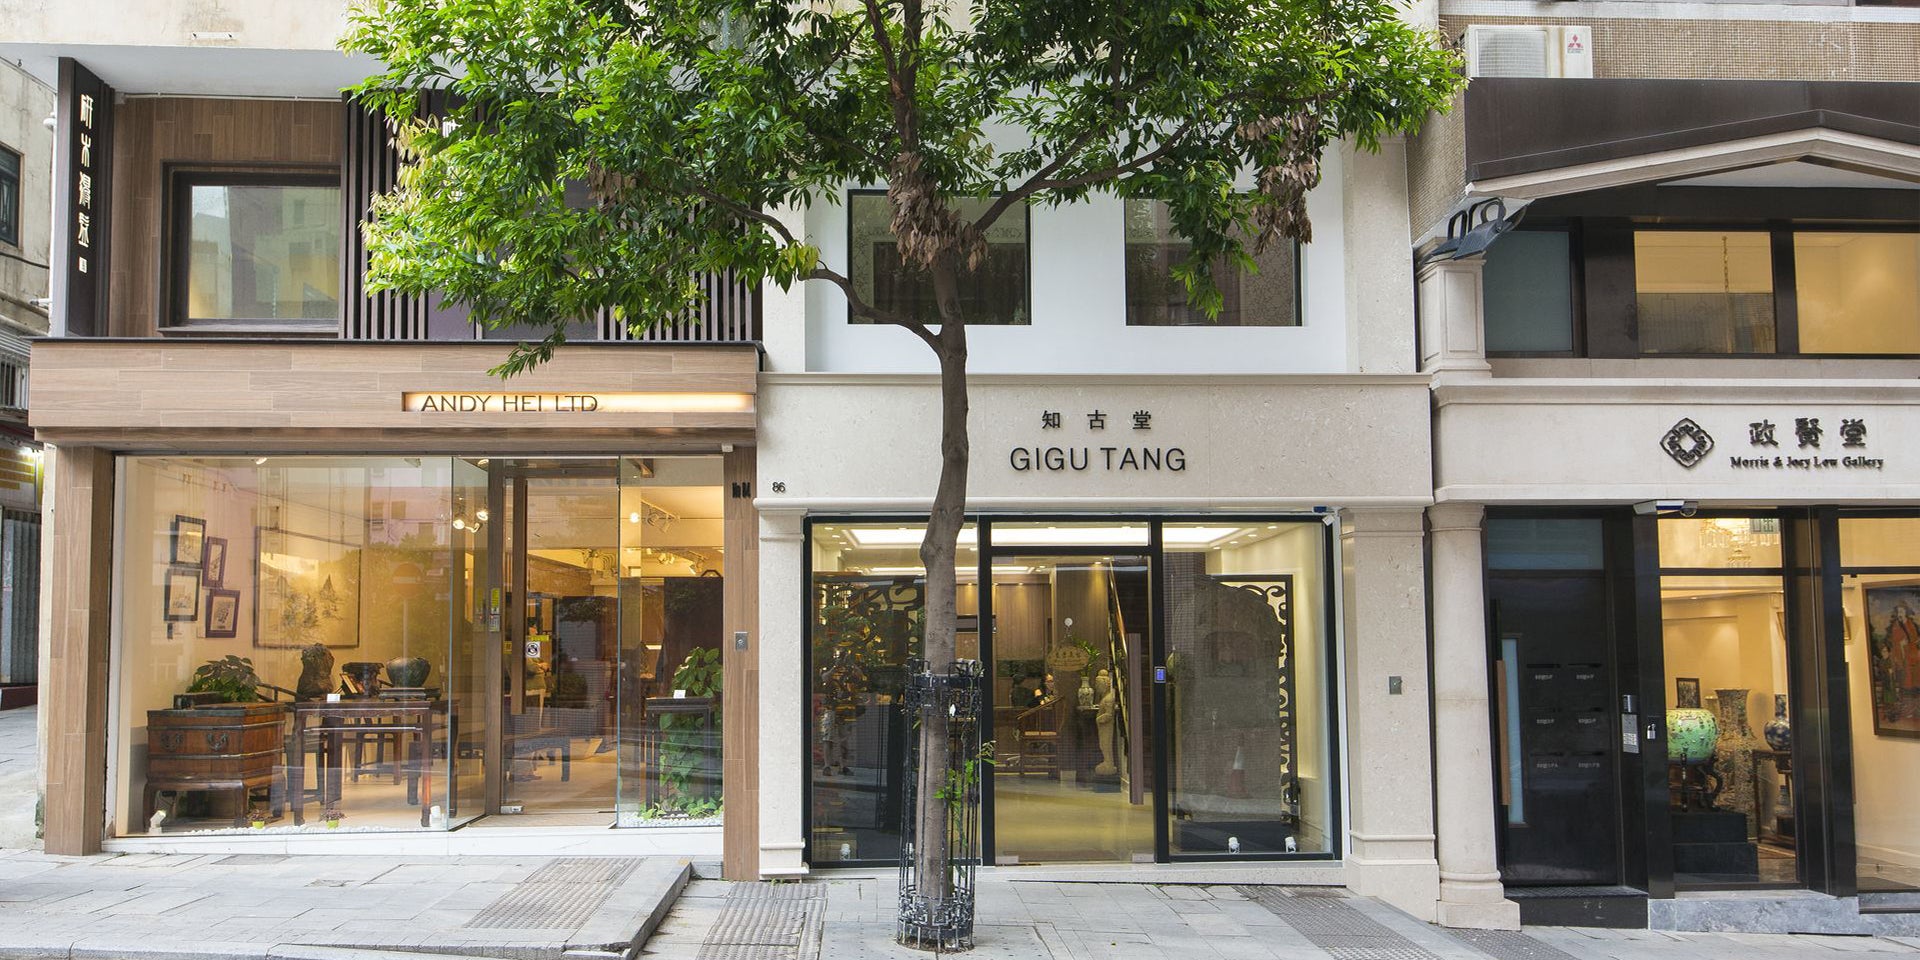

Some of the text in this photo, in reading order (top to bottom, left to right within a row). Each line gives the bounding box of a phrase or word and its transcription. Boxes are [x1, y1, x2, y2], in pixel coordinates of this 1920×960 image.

[421, 395, 598, 412] ANDY HEI LTD
[1042, 410, 1152, 430] 知古堂
[1749, 418, 1867, 448] 政賢堂
[1010, 447, 1186, 471] GIGU TANG
[1730, 456, 1769, 468] Morris
[1773, 456, 1783, 467] &
[1842, 456, 1884, 470] Gallery
[772, 482, 786, 492] 86
